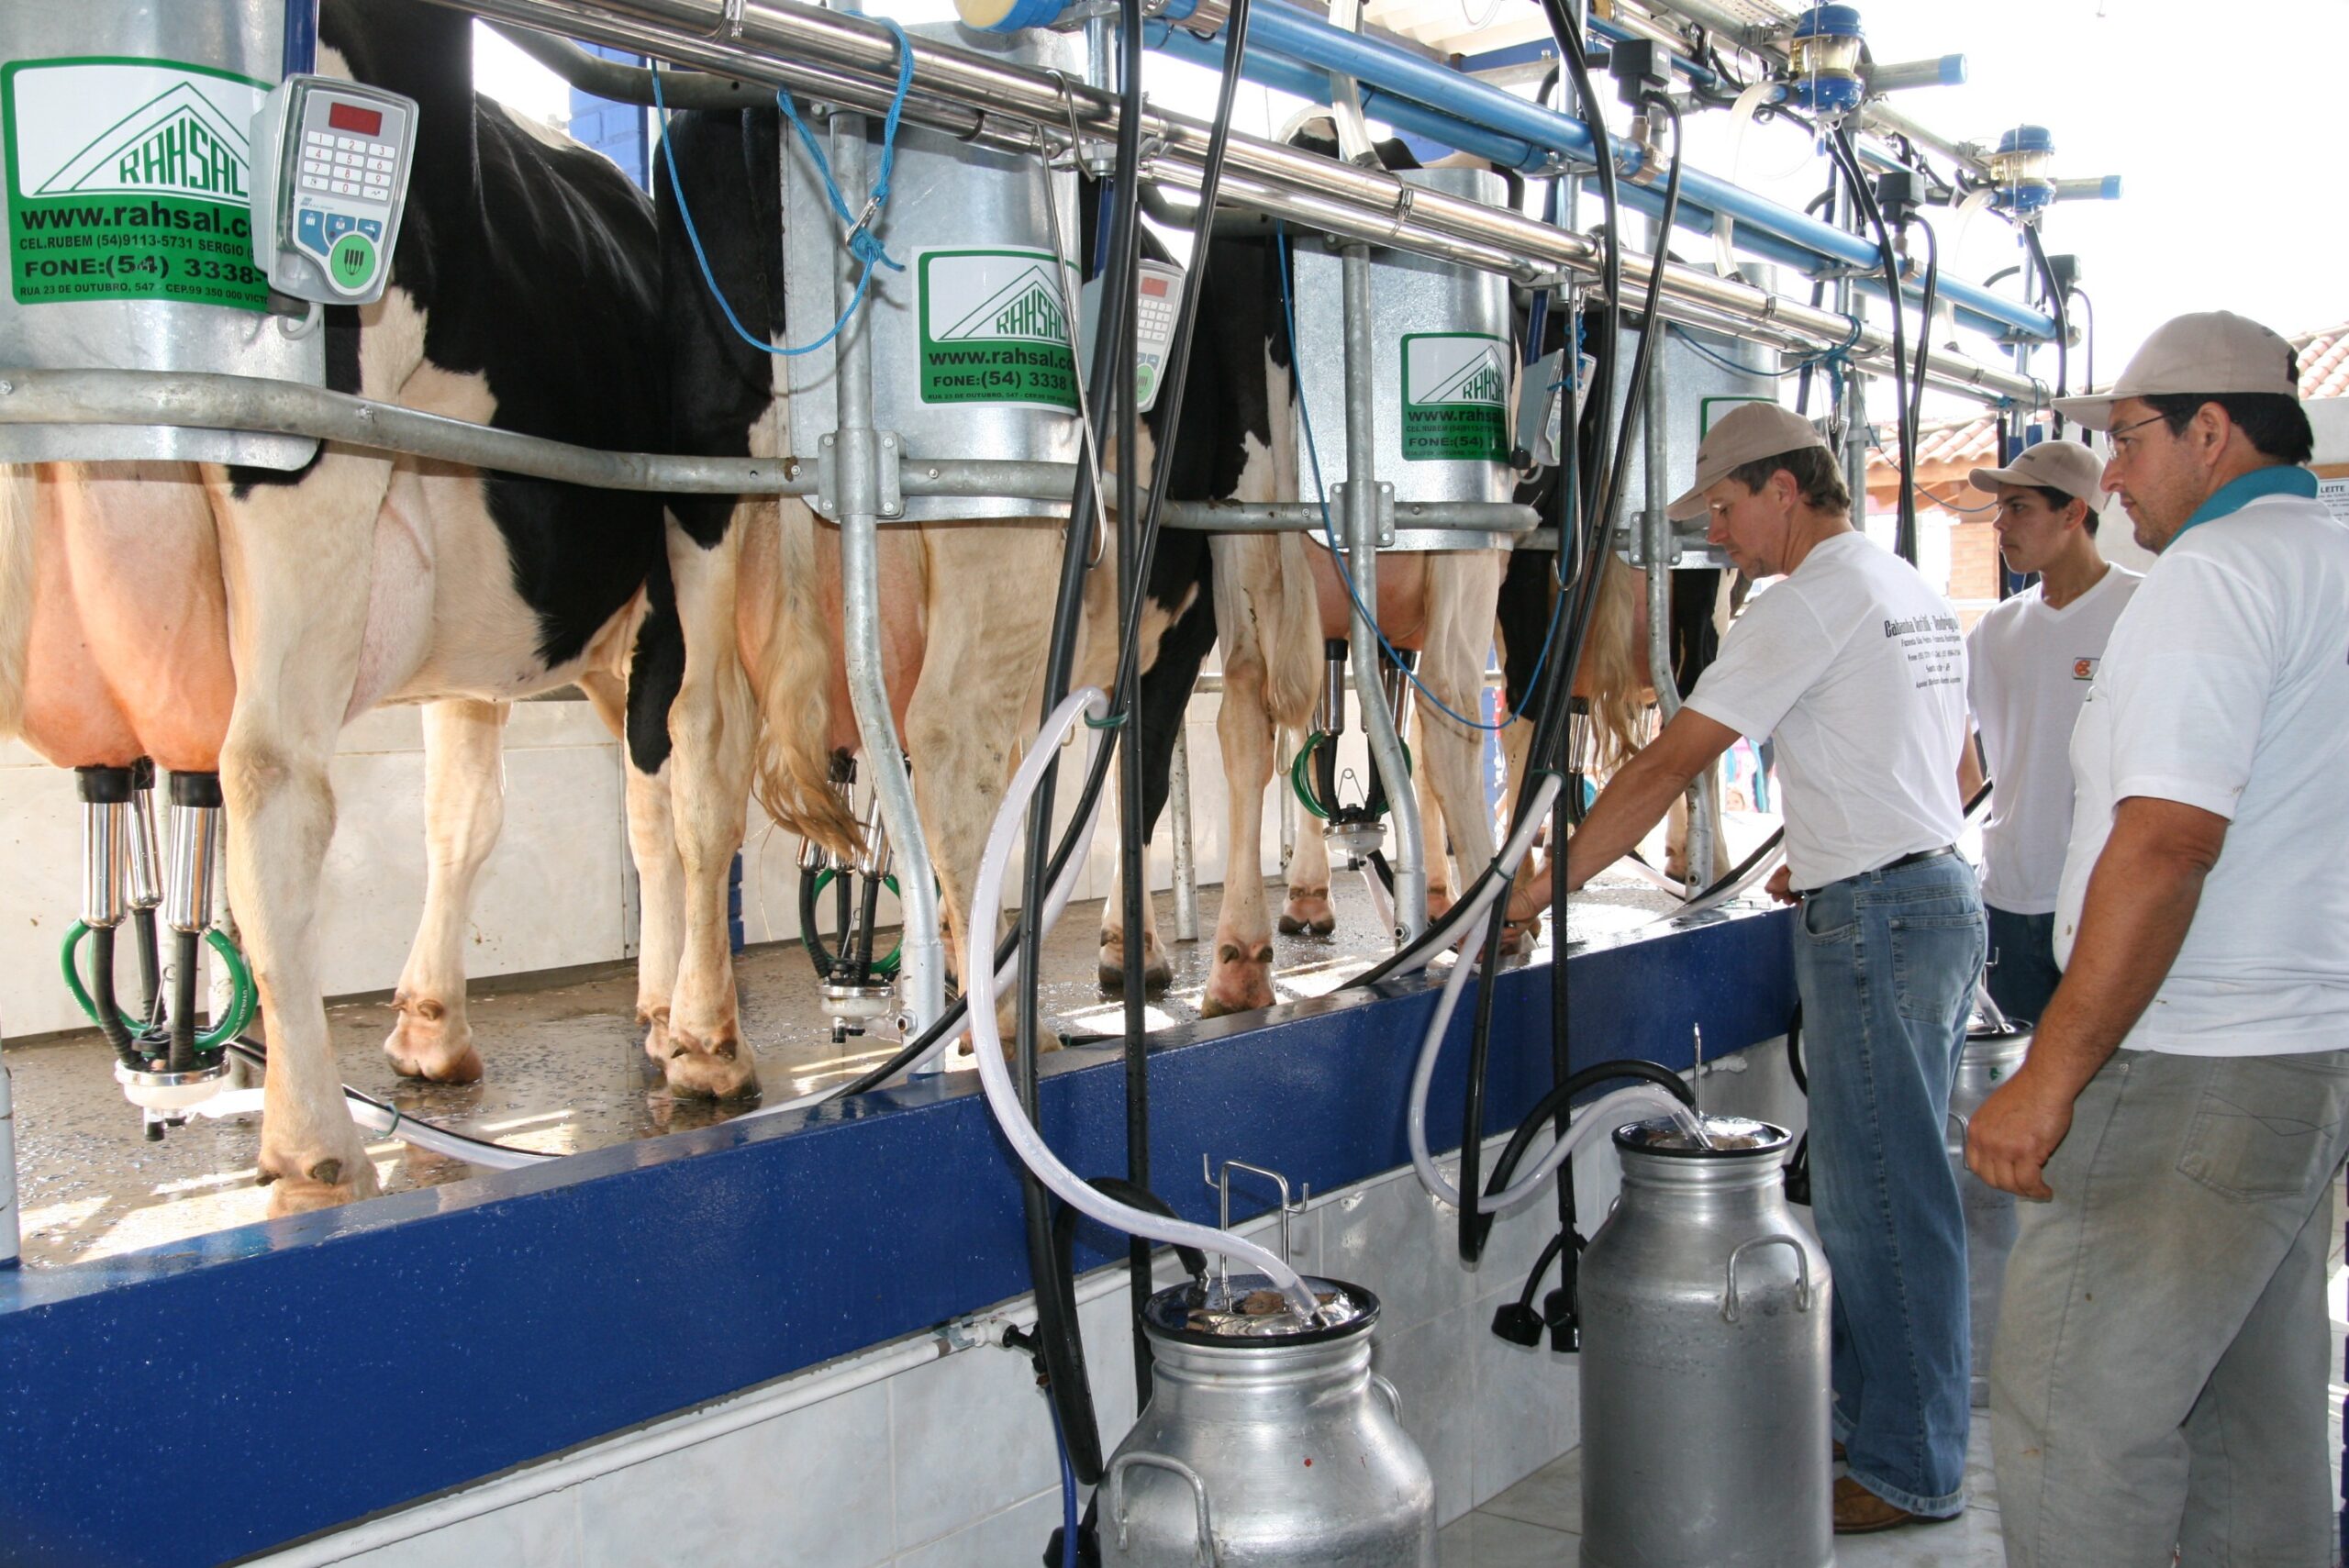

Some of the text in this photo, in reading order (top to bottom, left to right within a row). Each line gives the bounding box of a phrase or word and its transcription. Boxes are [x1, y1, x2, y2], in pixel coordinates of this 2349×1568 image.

[119, 117, 248, 198] RAHSAL
[349, 140, 355, 150] 2
[379, 146, 385, 156] 3
[315, 149, 383, 171] 4 5 6
[314, 163, 382, 184] 7 8 9
[342, 183, 349, 194] 0
[20, 201, 253, 239] www.rahsal.c
[19, 235, 93, 250] CEL.RUBEM
[96, 235, 193, 250] (54)9113-5731
[198, 239, 243, 256] SERGIO
[20, 286, 40, 295] RUA
[43, 284, 56, 294] 23
[59, 284, 71, 294] DE
[74, 283, 131, 293] OUTUBRO,
[135, 283, 154, 292] 547
[996, 288, 1067, 341] RAHSAL
[1029, 372, 1066, 390] 3338
